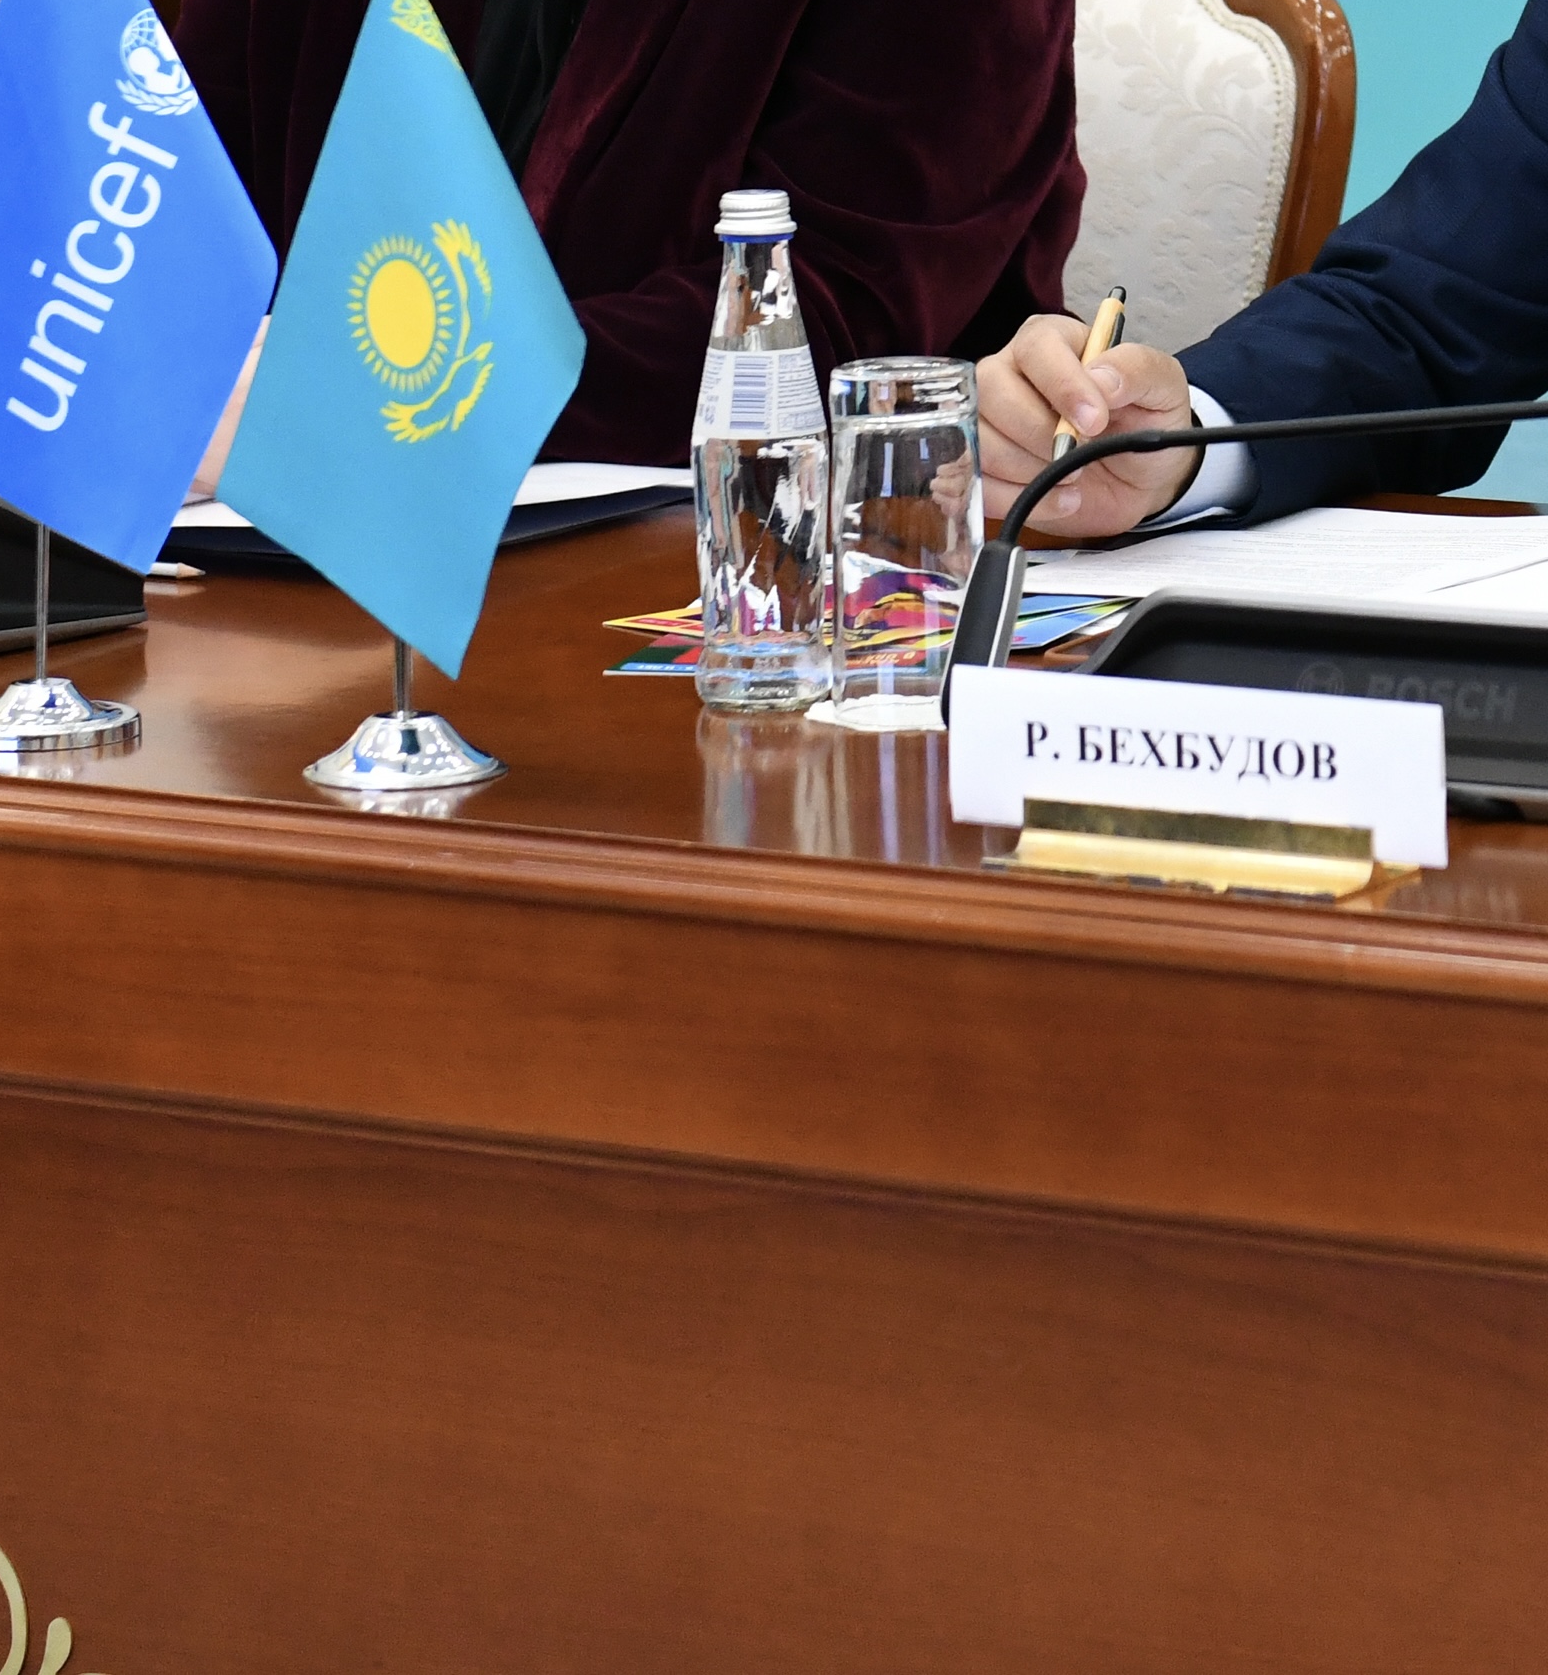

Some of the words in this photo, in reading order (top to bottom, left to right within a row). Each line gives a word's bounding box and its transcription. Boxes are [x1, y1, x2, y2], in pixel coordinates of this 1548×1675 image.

[5, 101, 179, 432] unicef
[1025, 720, 1060, 760] Р.
[1078, 723, 1338, 784] БЕХБУДОВ
